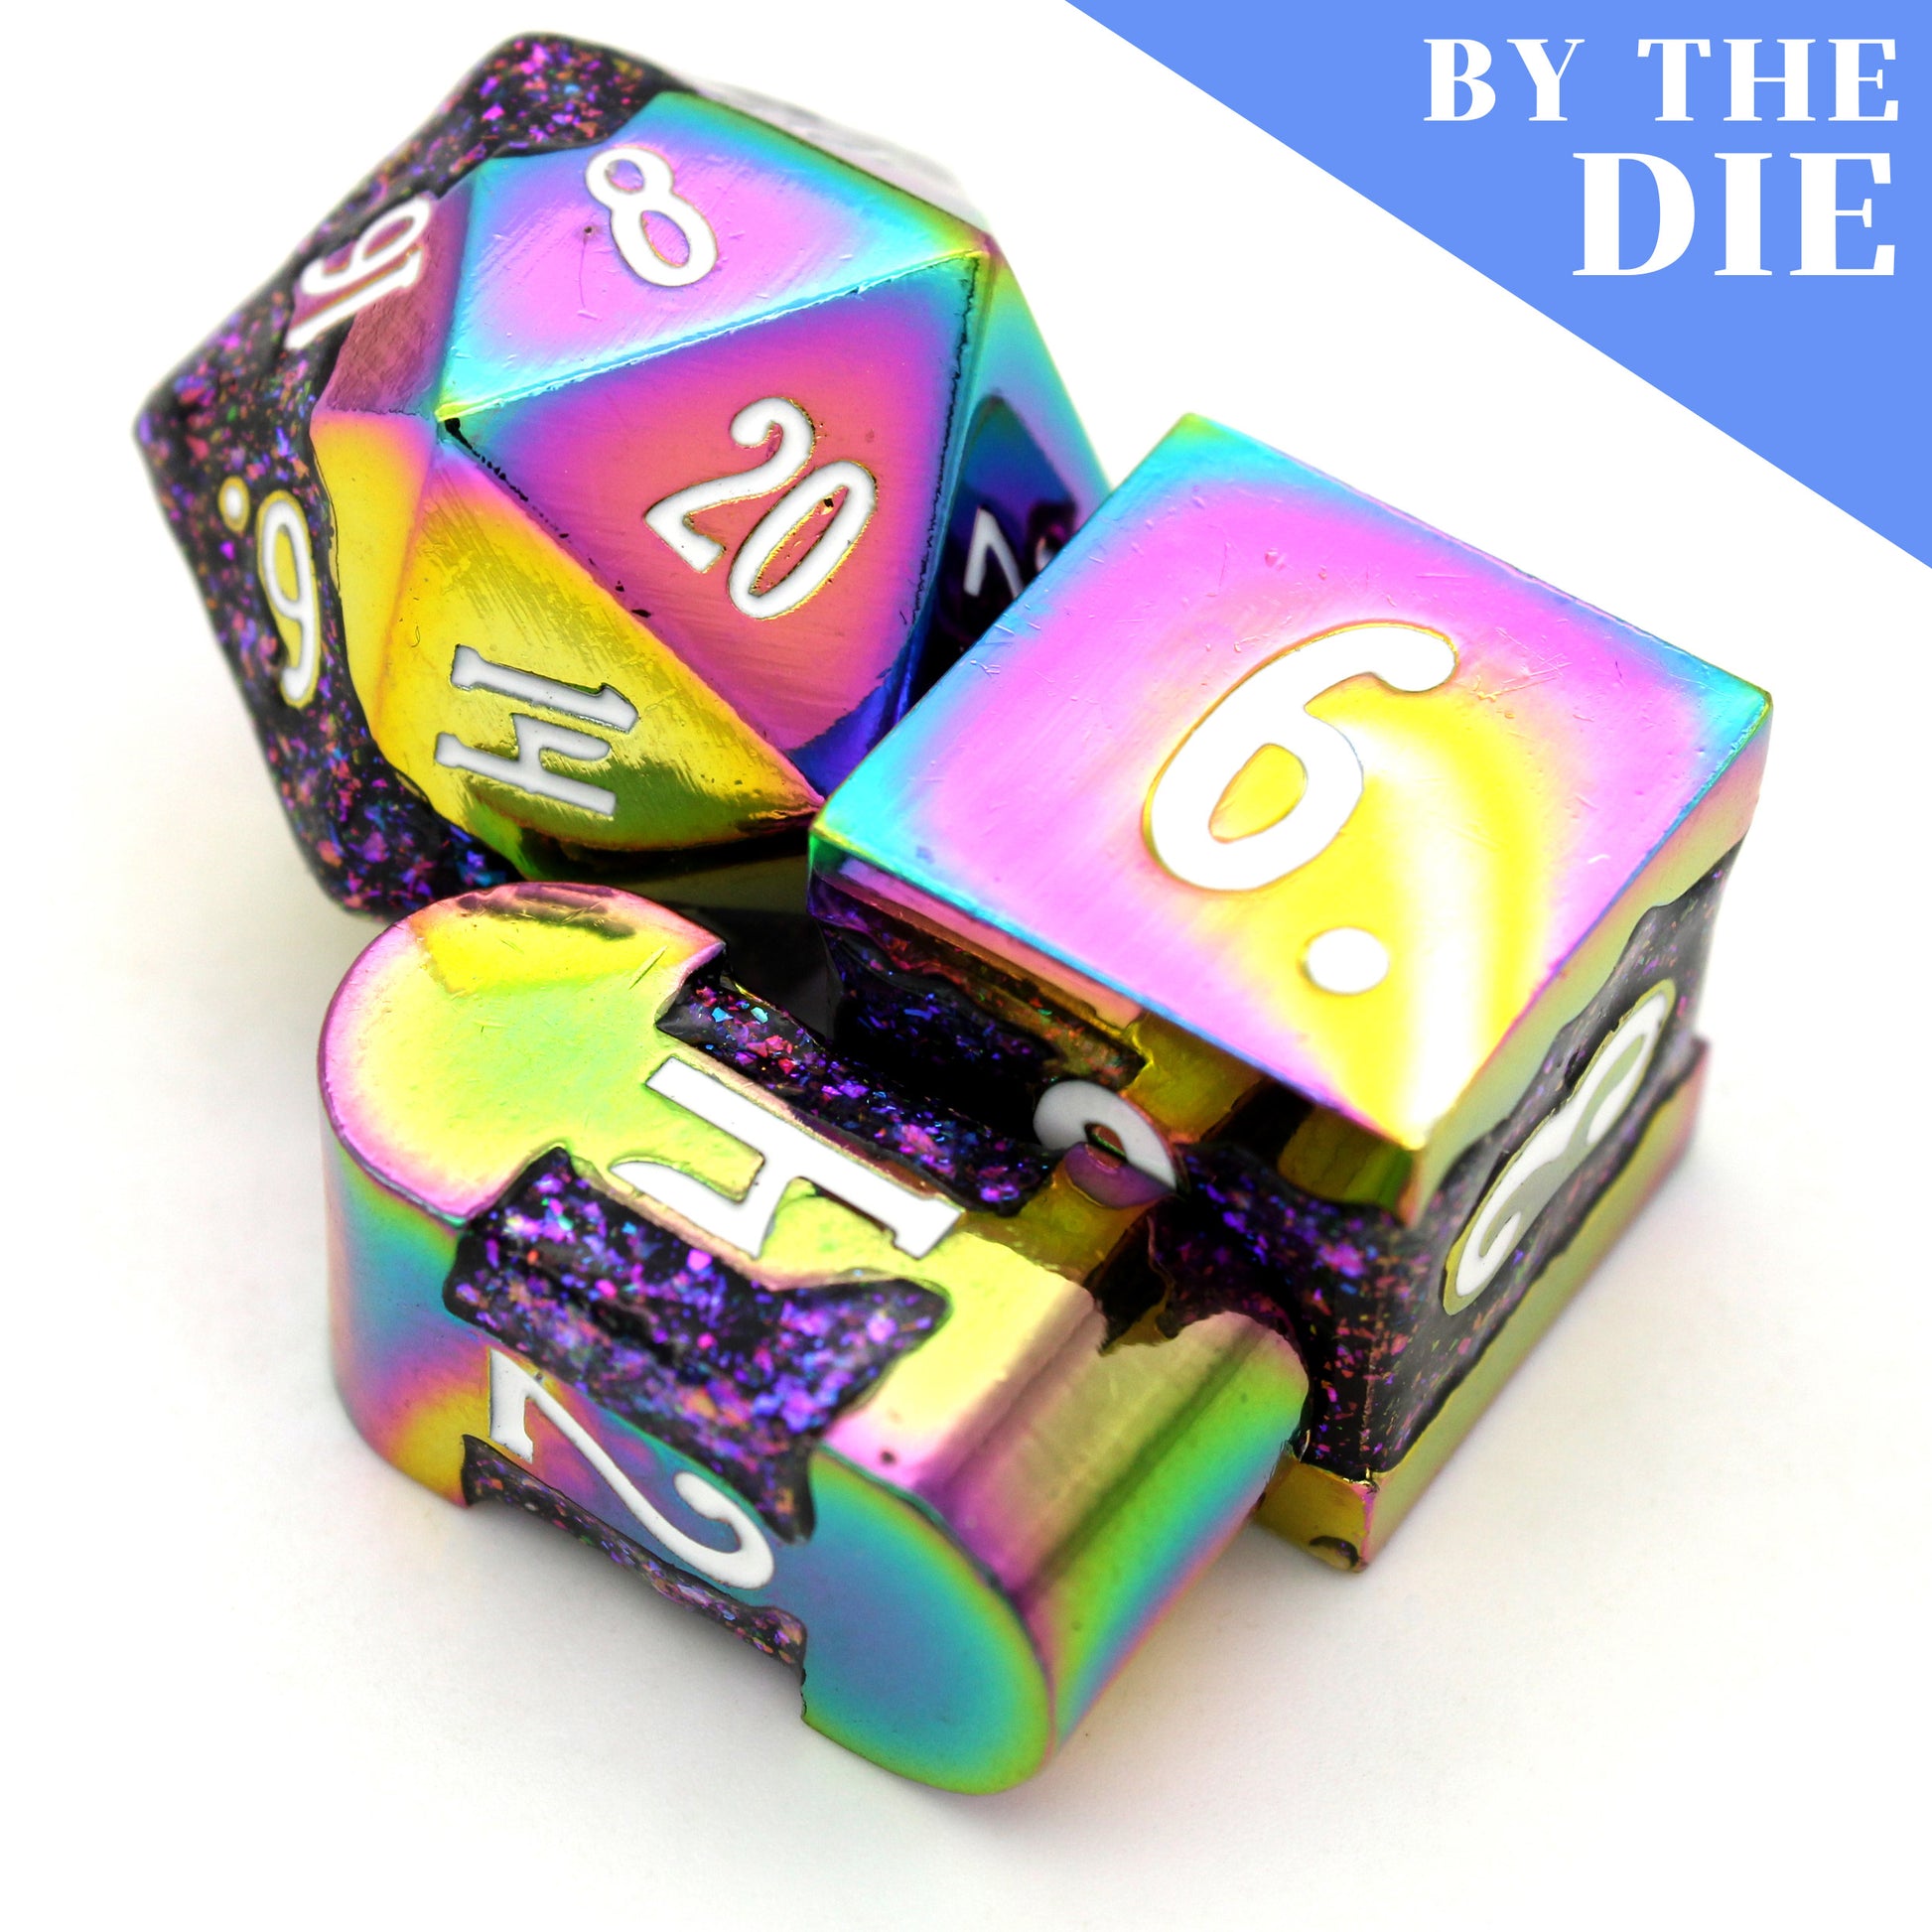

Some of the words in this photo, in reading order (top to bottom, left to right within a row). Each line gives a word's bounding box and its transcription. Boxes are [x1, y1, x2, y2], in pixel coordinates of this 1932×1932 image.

[284, 195, 432, 351] 16
[584, 145, 719, 288] 8
[643, 396, 879, 621] 20
[435, 644, 639, 817] 14
[645, 1055, 965, 1260] 4
[488, 1346, 774, 1589] 2
